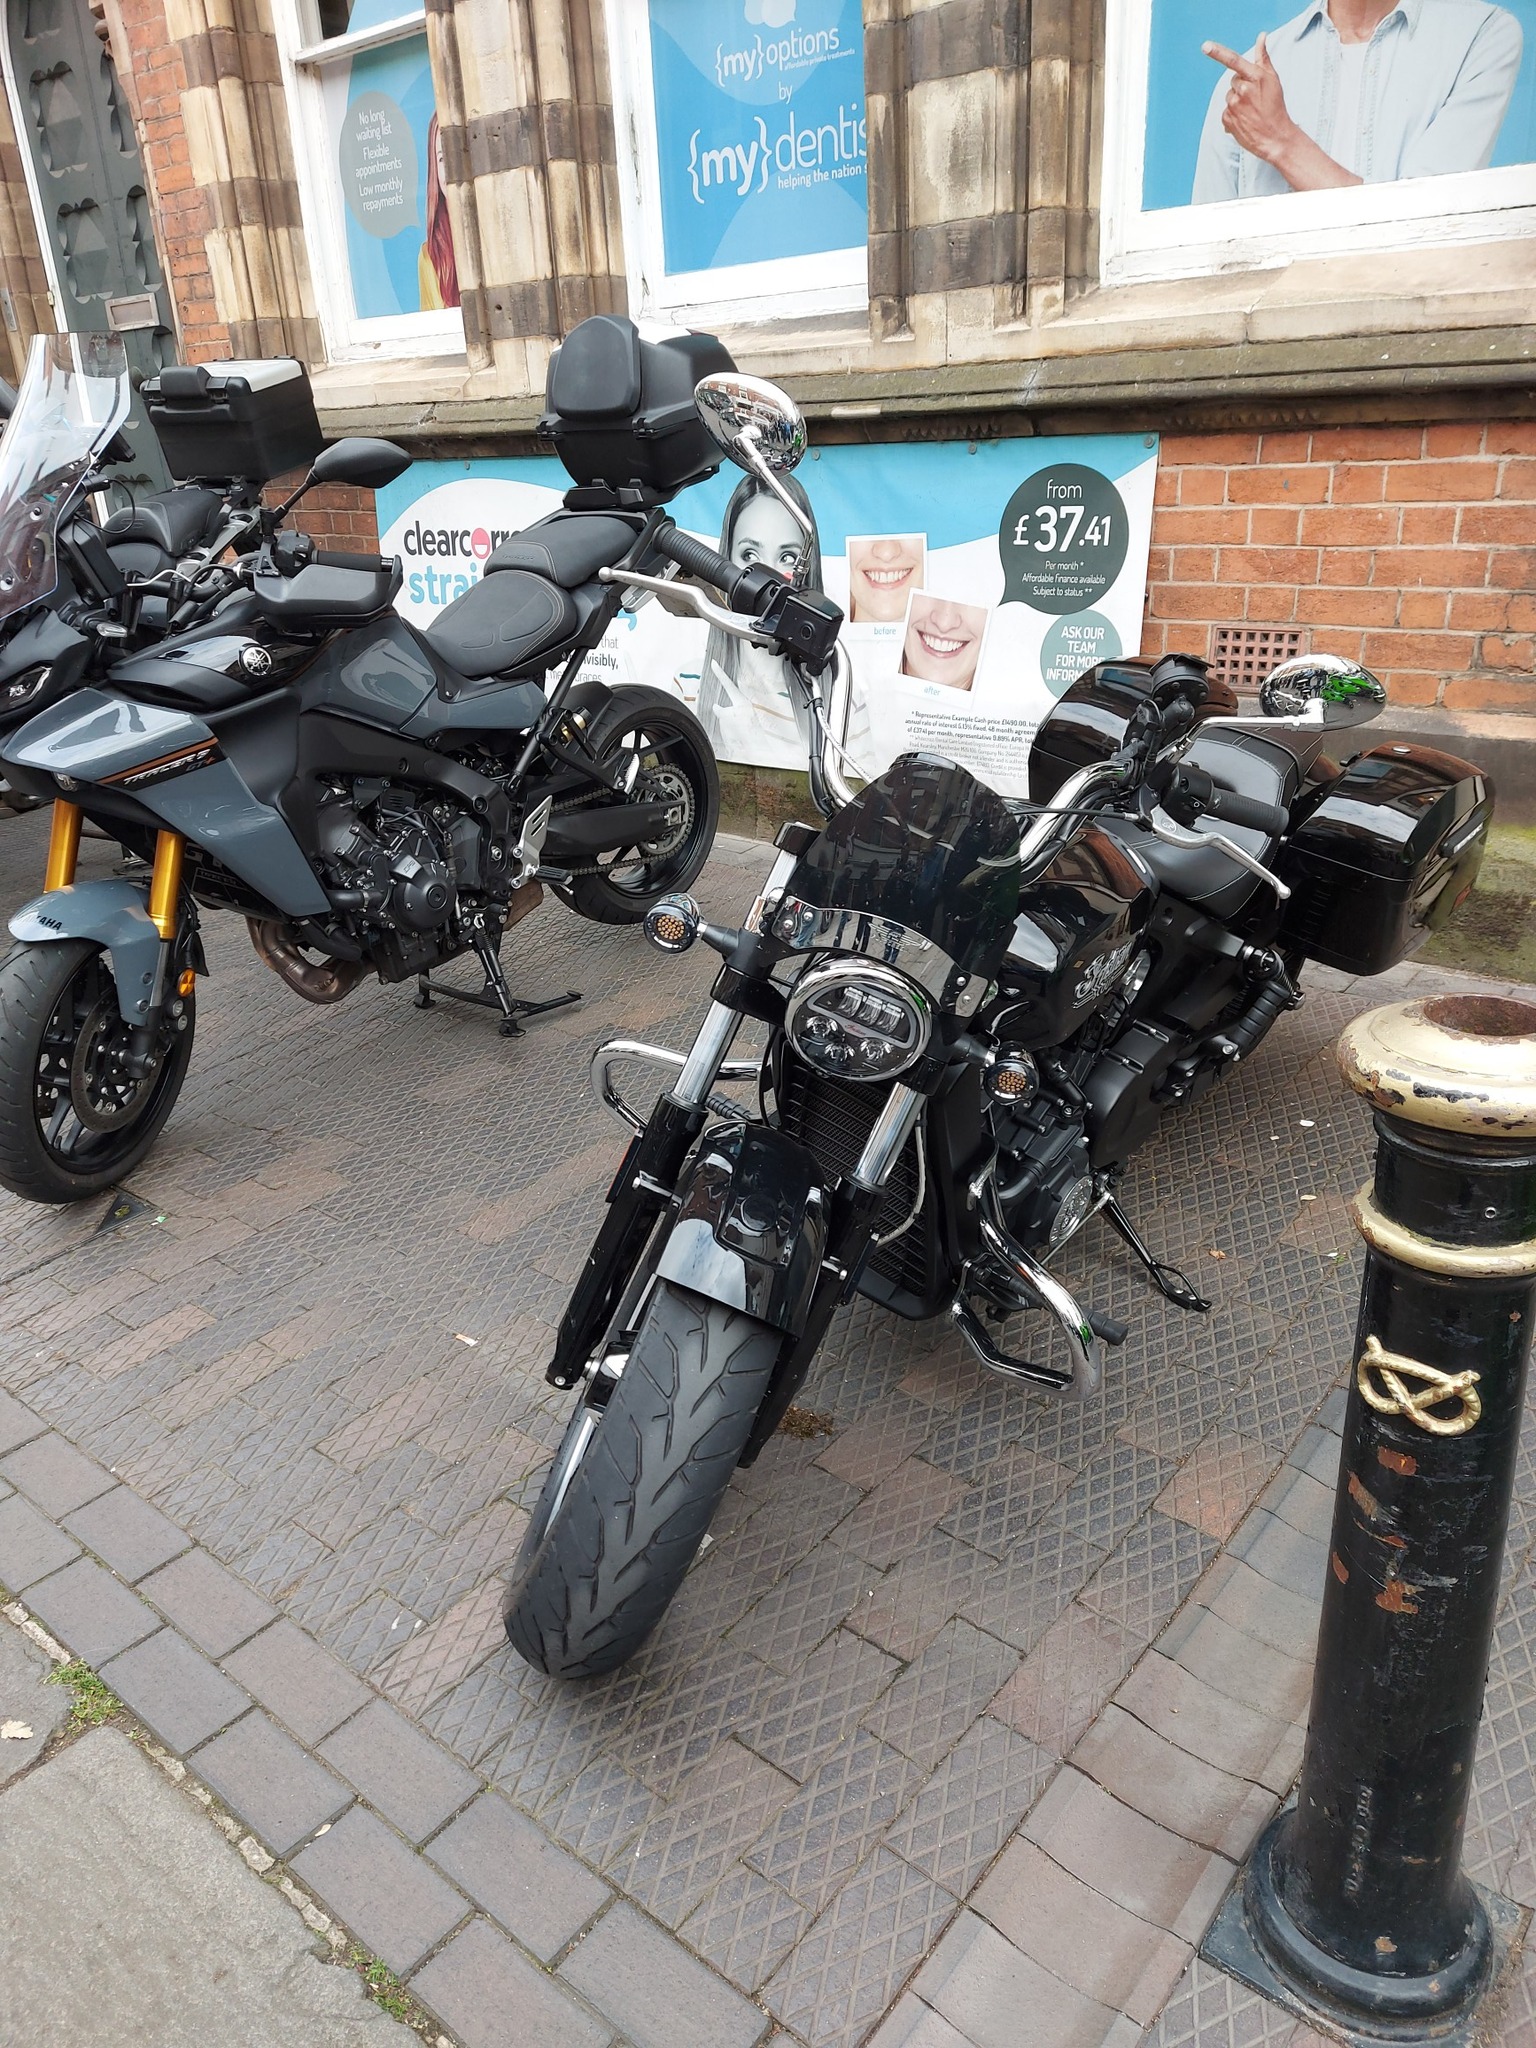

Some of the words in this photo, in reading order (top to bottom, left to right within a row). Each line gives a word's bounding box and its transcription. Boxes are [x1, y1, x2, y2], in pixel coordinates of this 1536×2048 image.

[779, 81, 793, 104] by
[359, 112, 369, 125] No
[370, 109, 386, 124] long
[356, 126, 381, 141] waiting
[381, 122, 392, 135] list
[363, 143, 390, 160] Flexible
[355, 157, 403, 180] appointments
[777, 174, 811, 190] helping
[813, 168, 829, 183] the
[831, 163, 862, 179] nation
[359, 184, 374, 196] Low
[374, 176, 403, 193] monthly
[363, 193, 404, 213] repayments
[1046, 479, 1082, 499] from
[1013, 505, 1112, 553] £37.41
[1045, 560, 1056, 570] Per
[1057, 561, 1079, 570] month
[1022, 572, 1054, 583] Affordable
[1079, 574, 1106, 584] available
[1032, 586, 1056, 598] Subject
[1056, 587, 1064, 596] to
[1064, 587, 1083, 597] status
[874, 627, 897, 635] before
[1061, 626, 1082, 639] ASK
[1083, 626, 1105, 640] OUR
[601, 635, 619, 649] that
[1067, 640, 1097, 654] TEAM
[1055, 654, 1075, 667] FOR
[924, 686, 940, 696] after
[915, 710, 951, 720] Representative
[952, 715, 973, 723] Example
